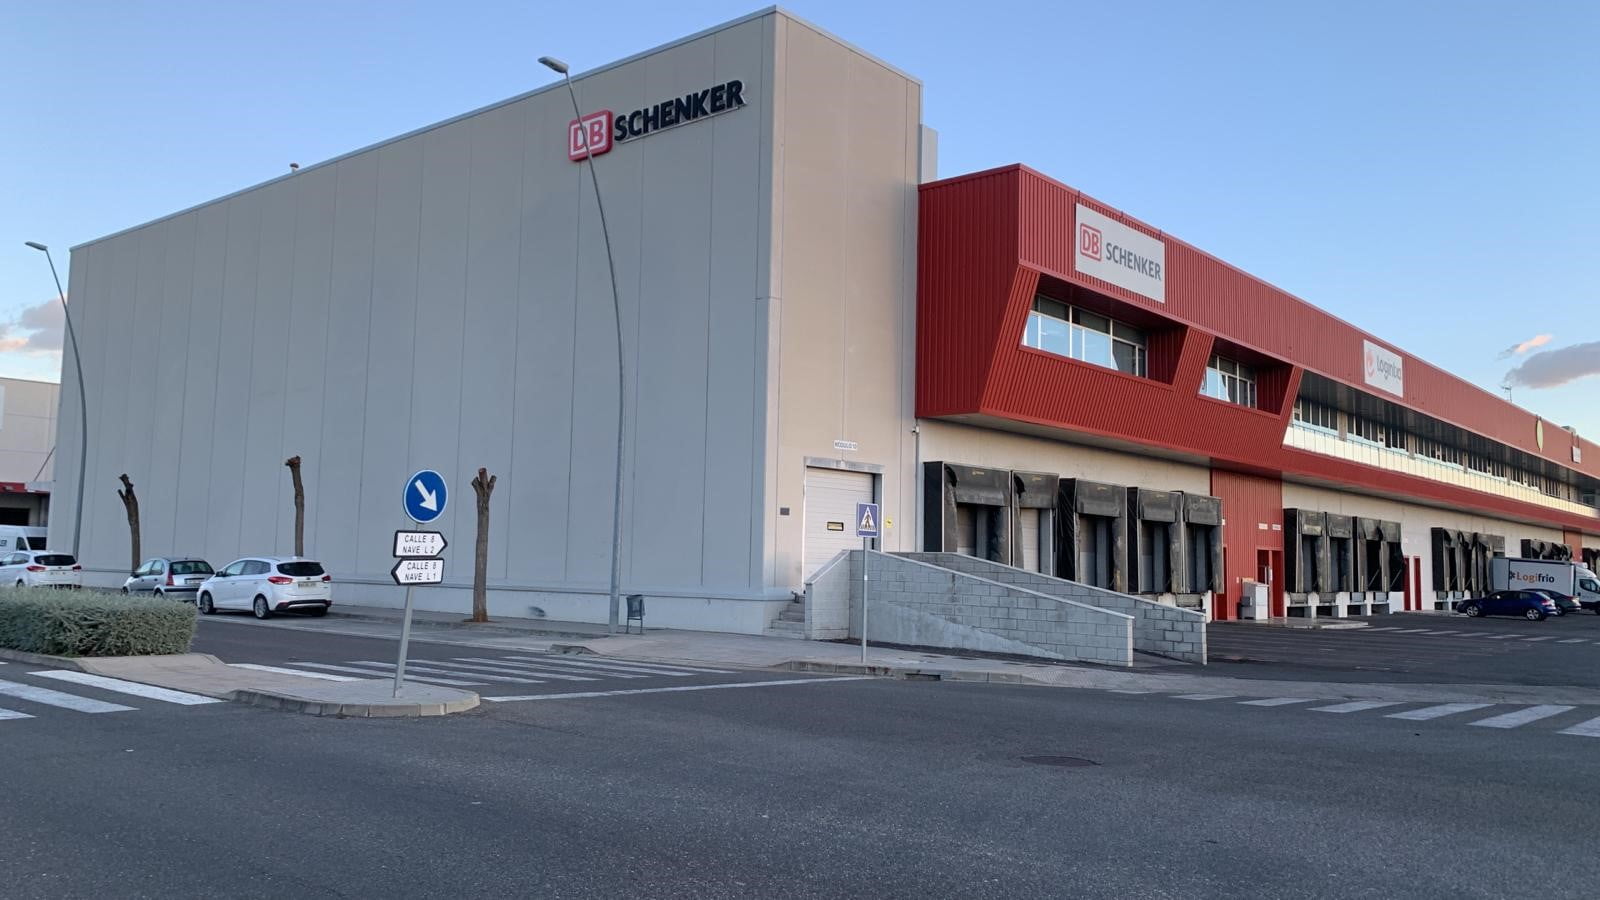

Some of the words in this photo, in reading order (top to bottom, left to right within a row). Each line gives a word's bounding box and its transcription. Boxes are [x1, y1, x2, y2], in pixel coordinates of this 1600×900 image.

[571, 115, 607, 154] DB
[614, 79, 744, 142] SCHENKER
[1081, 226, 1100, 257] DB
[1105, 242, 1161, 280] SCHENKER
[404, 534, 427, 543] CALLE
[402, 545, 420, 553] NAVE
[424, 545, 428, 553] L
[430, 545, 435, 553] 2
[407, 562, 429, 570] CALLE
[404, 572, 423, 581] NAVE
[1516, 571, 1555, 583] Logifrio
